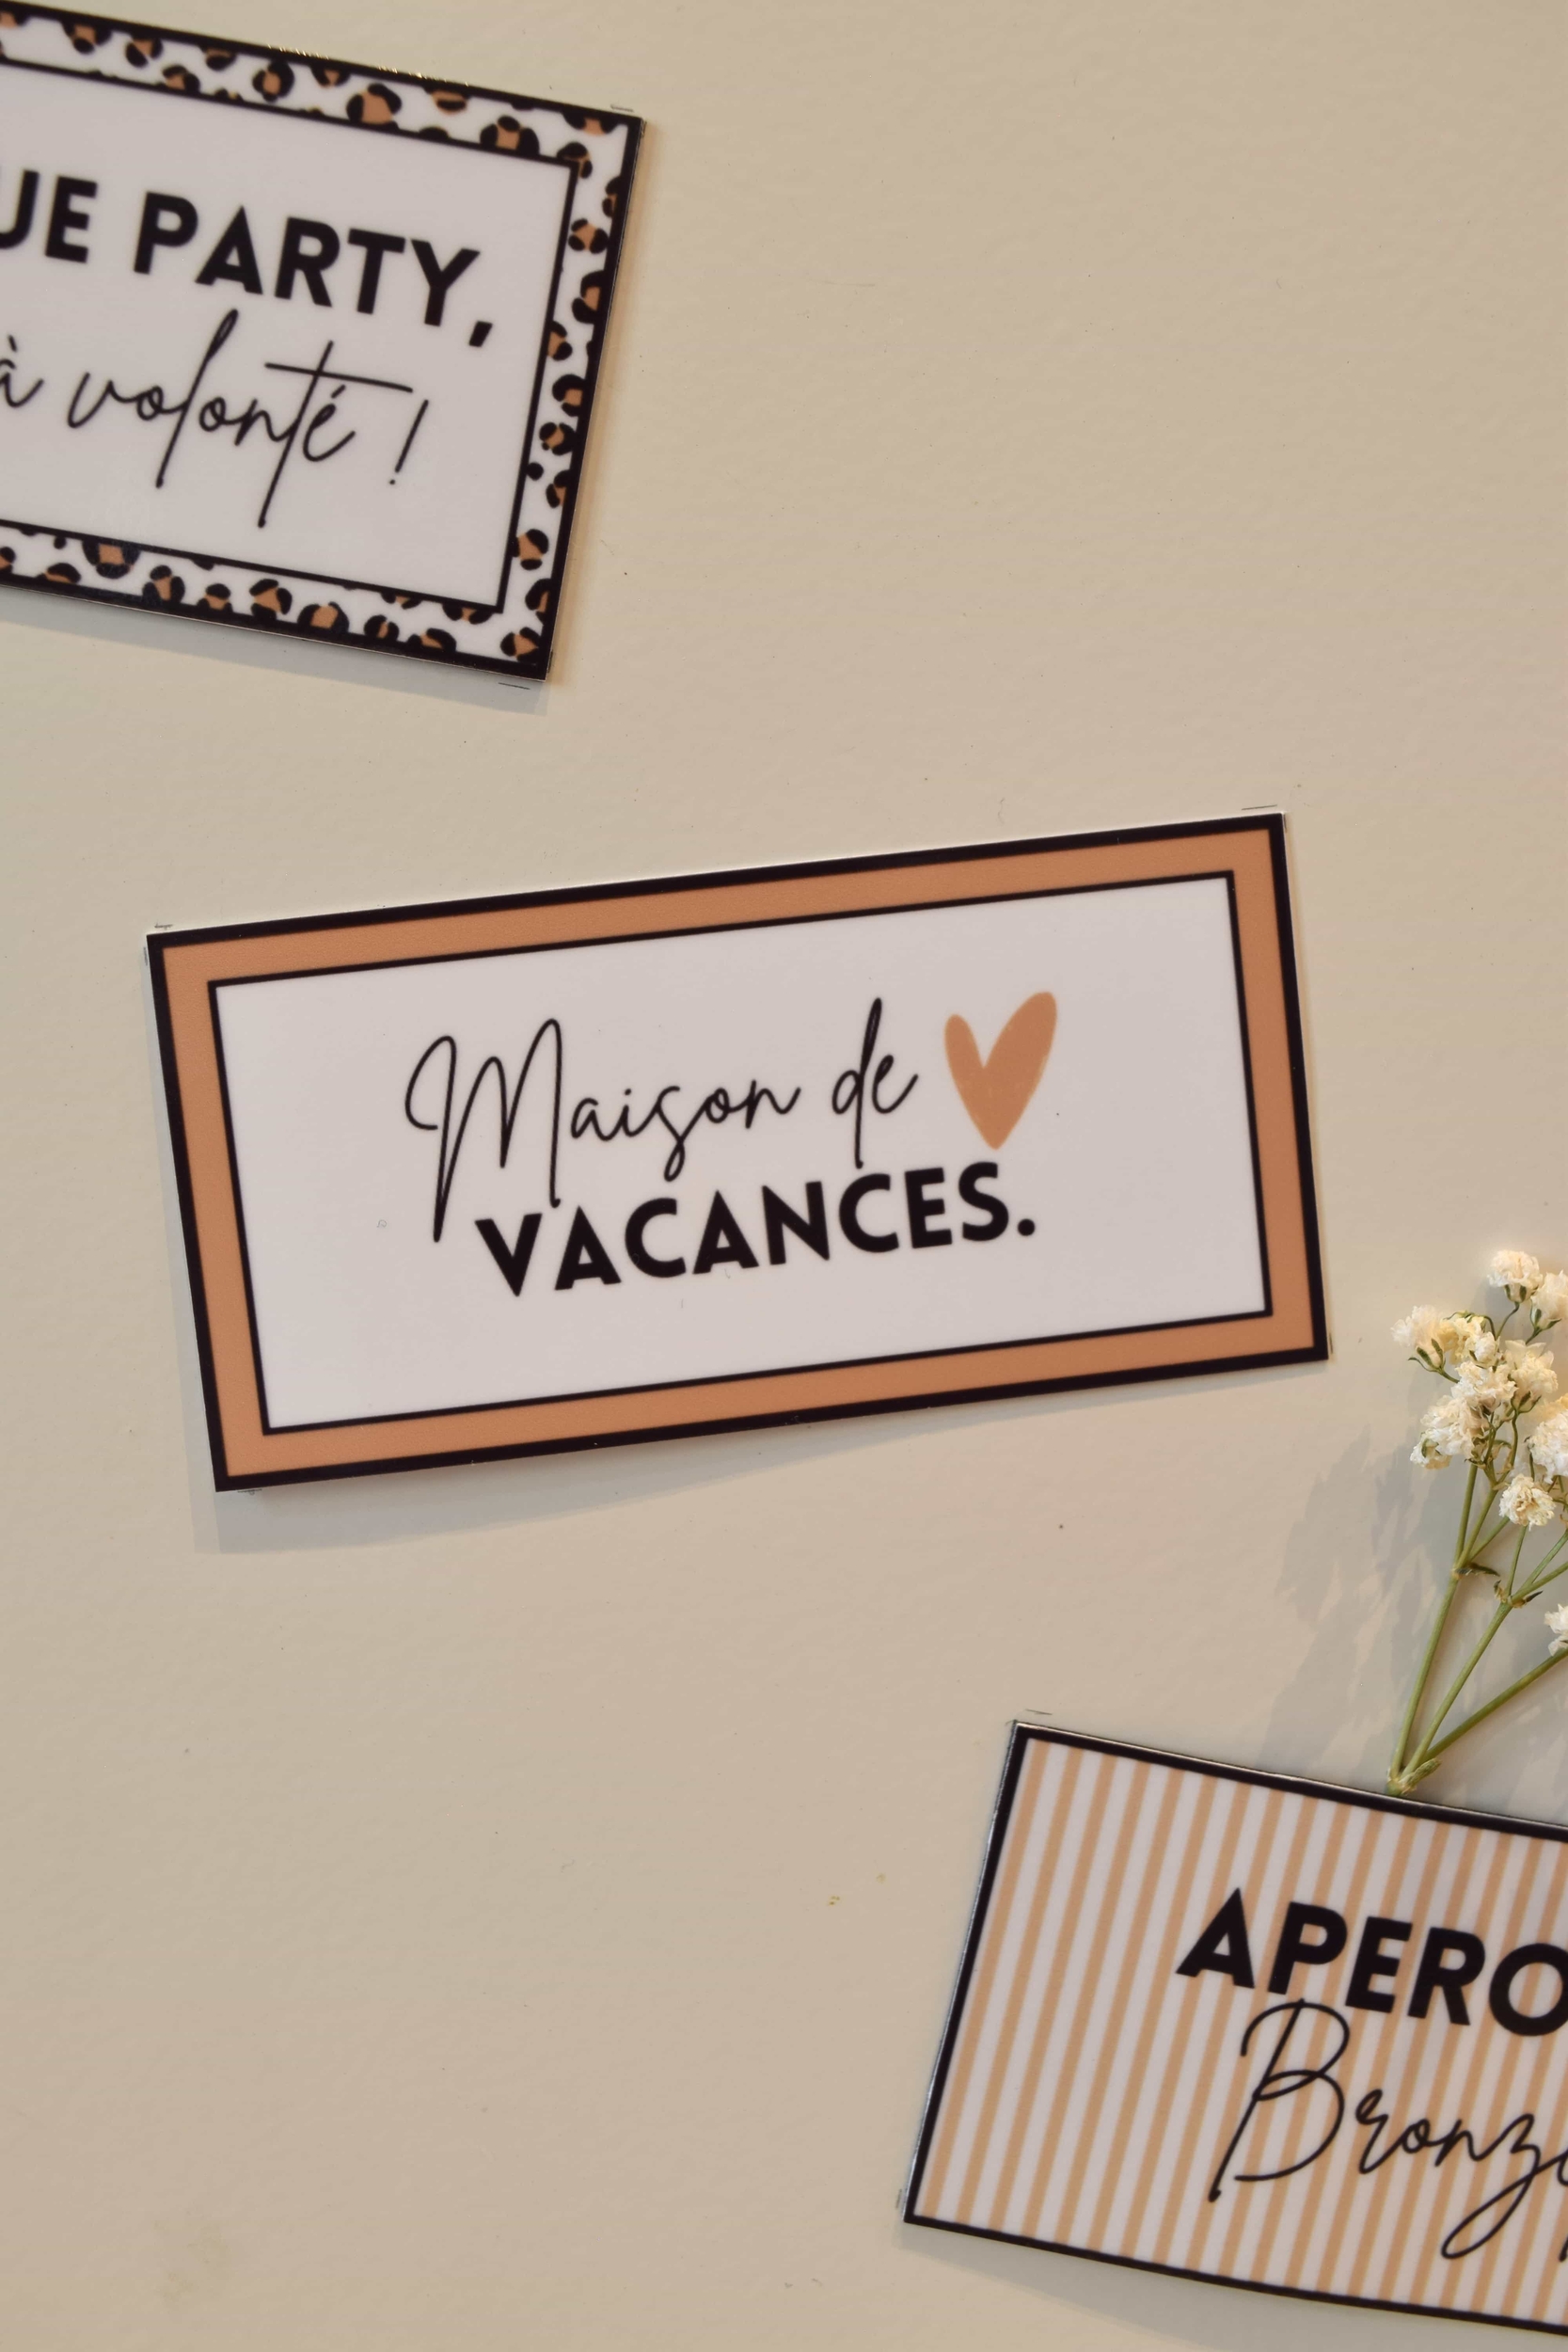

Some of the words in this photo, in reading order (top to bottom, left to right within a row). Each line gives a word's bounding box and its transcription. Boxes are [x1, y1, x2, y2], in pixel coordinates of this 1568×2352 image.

[134, 192, 493, 347] PARTY,
[67, 309, 413, 529] volonté
[388, 400, 429, 485] !
[404, 1018, 801, 1243] Maison
[832, 997, 918, 1169] de
[475, 1161, 1036, 1296] VACANCES.
[1176, 1887, 1568, 2037] APERO
[1208, 1997, 1568, 2262] Bronz
